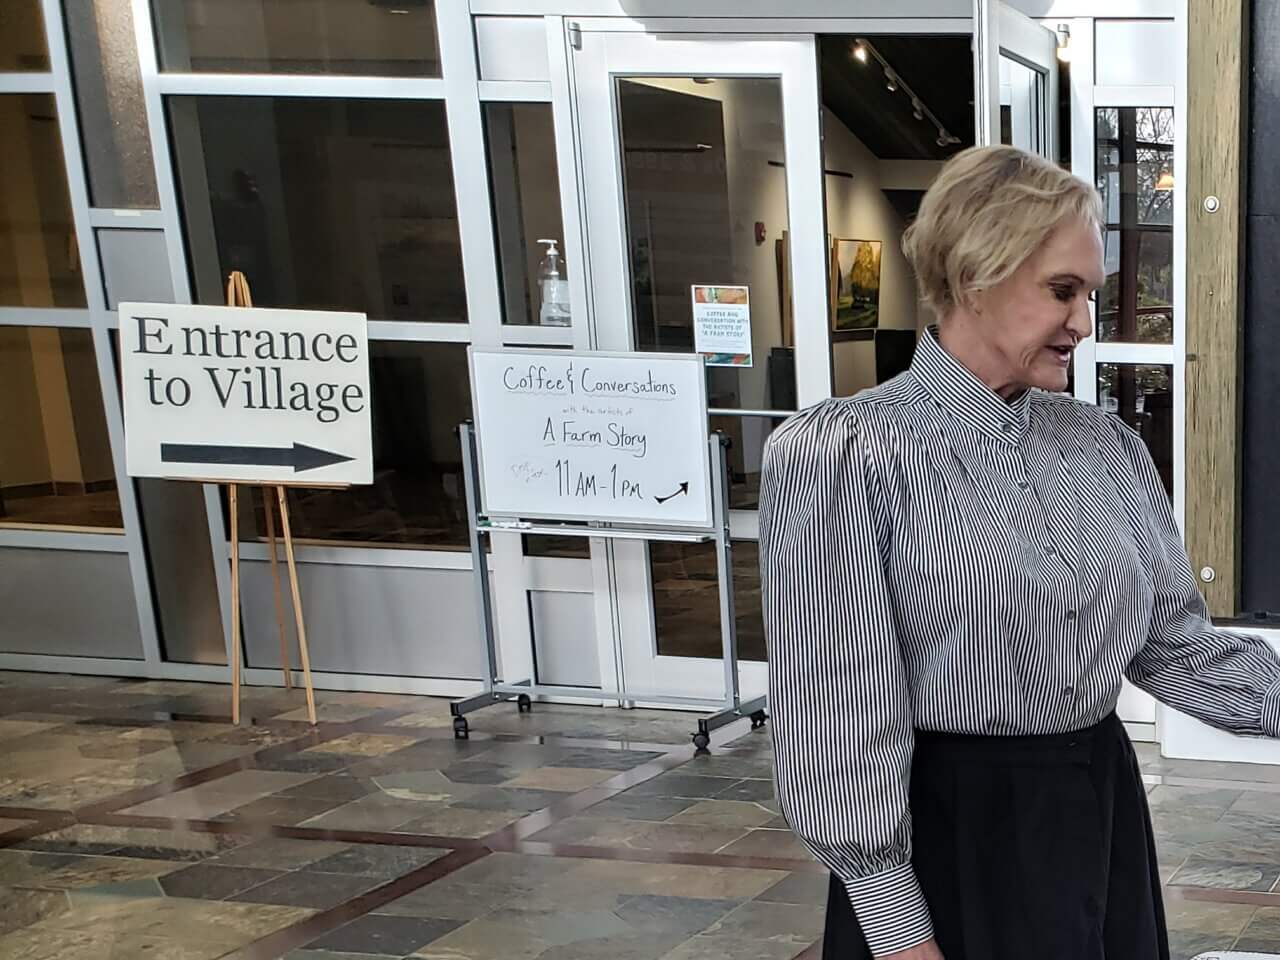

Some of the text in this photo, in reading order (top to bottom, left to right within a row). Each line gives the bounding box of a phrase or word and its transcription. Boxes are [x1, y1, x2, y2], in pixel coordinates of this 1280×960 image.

[130, 316, 359, 363] Entrance
[144, 366, 365, 423] to Village
[503, 366, 565, 391] Coffee
[581, 367, 677, 395] Conversations
[543, 417, 647, 458] A Farm Story
